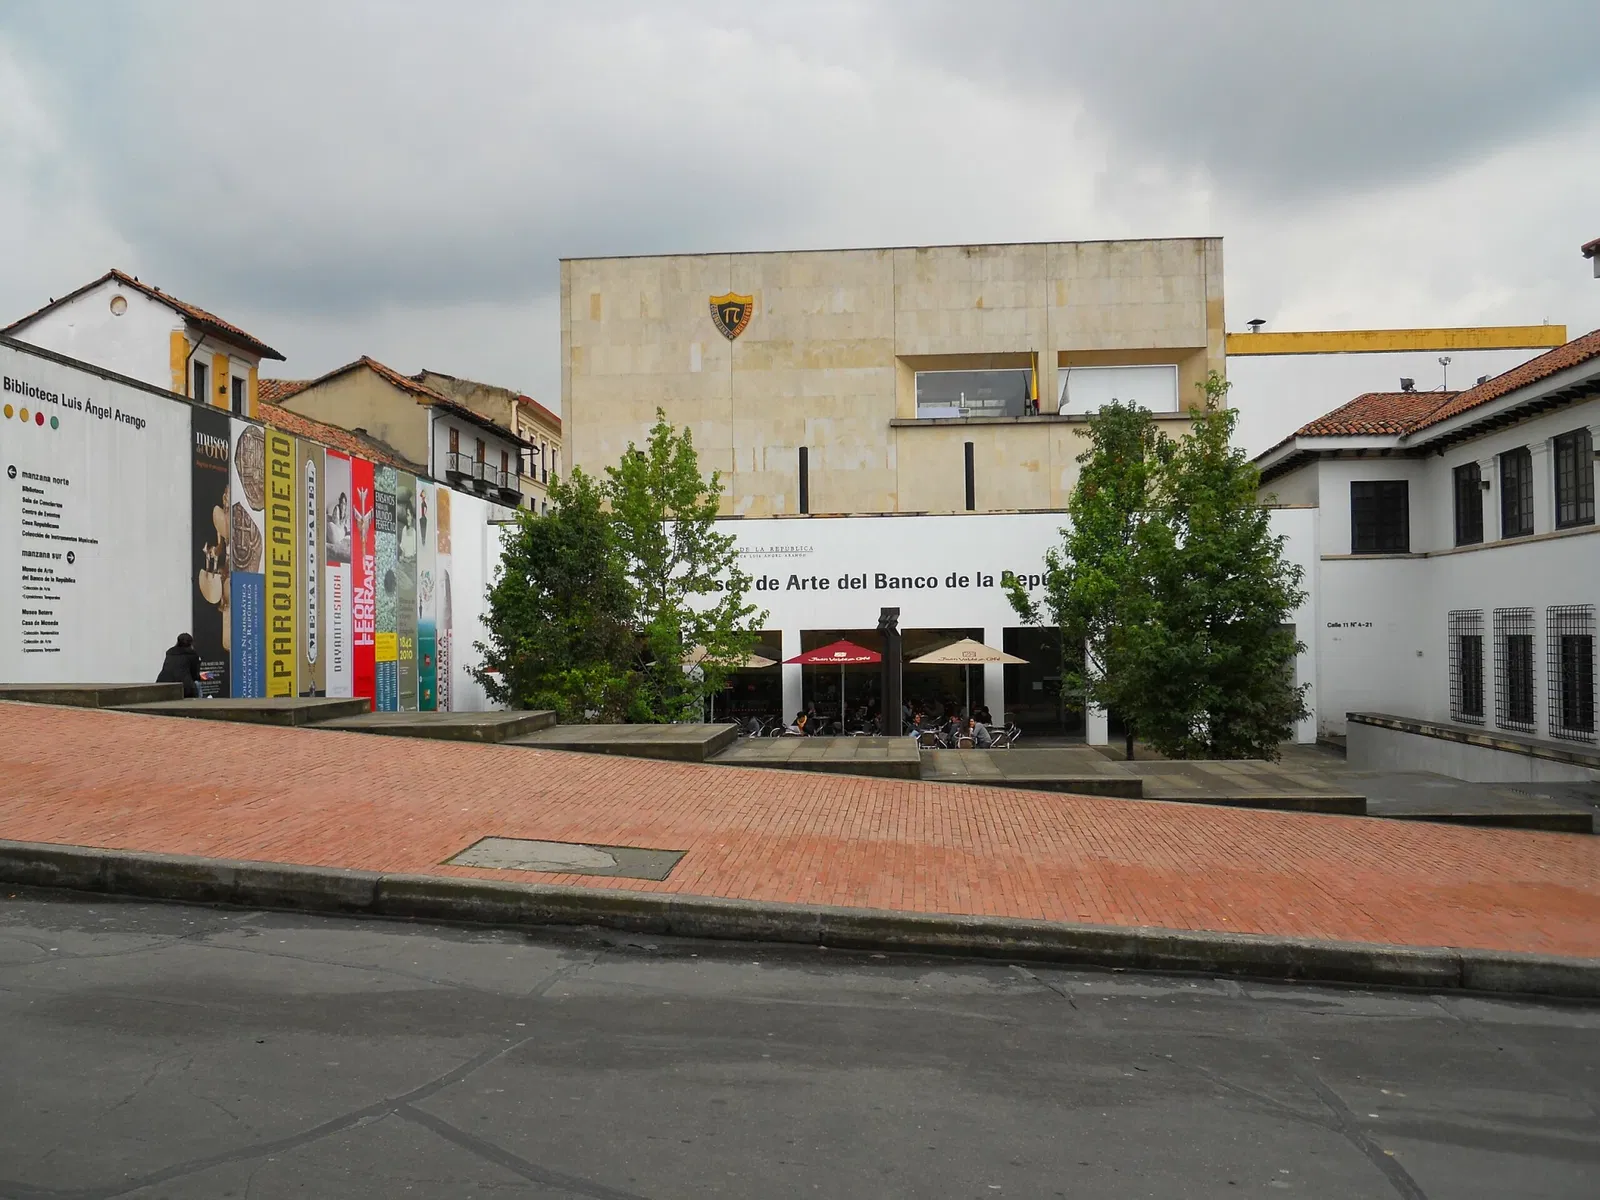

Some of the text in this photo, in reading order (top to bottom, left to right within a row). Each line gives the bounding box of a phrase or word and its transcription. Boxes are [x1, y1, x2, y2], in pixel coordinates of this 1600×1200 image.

[3, 376, 146, 430] Biblioteca Luis Ángel Arango
[196, 432, 229, 450] museo
[205, 444, 229, 462] oro
[22, 471, 70, 486] manzana norte
[375, 491, 396, 506] ENSAYOS
[308, 471, 316, 546] PAPEL
[376, 510, 392, 521] MUNDO
[376, 519, 396, 532] PERFECTO
[22, 550, 50, 559] manzana
[271, 436, 291, 678] PARQUEADERO
[756, 575, 780, 591] de
[786, 574, 830, 591] Arte
[837, 573, 867, 590] del
[874, 571, 938, 590] Banco
[945, 571, 969, 588] de
[976, 571, 994, 588] la
[362, 554, 374, 646] FERRARI
[308, 570, 316, 649] METAL
[352, 587, 364, 646] LEÓN
[400, 636, 412, 649] 1842
[400, 650, 413, 660] 2010
